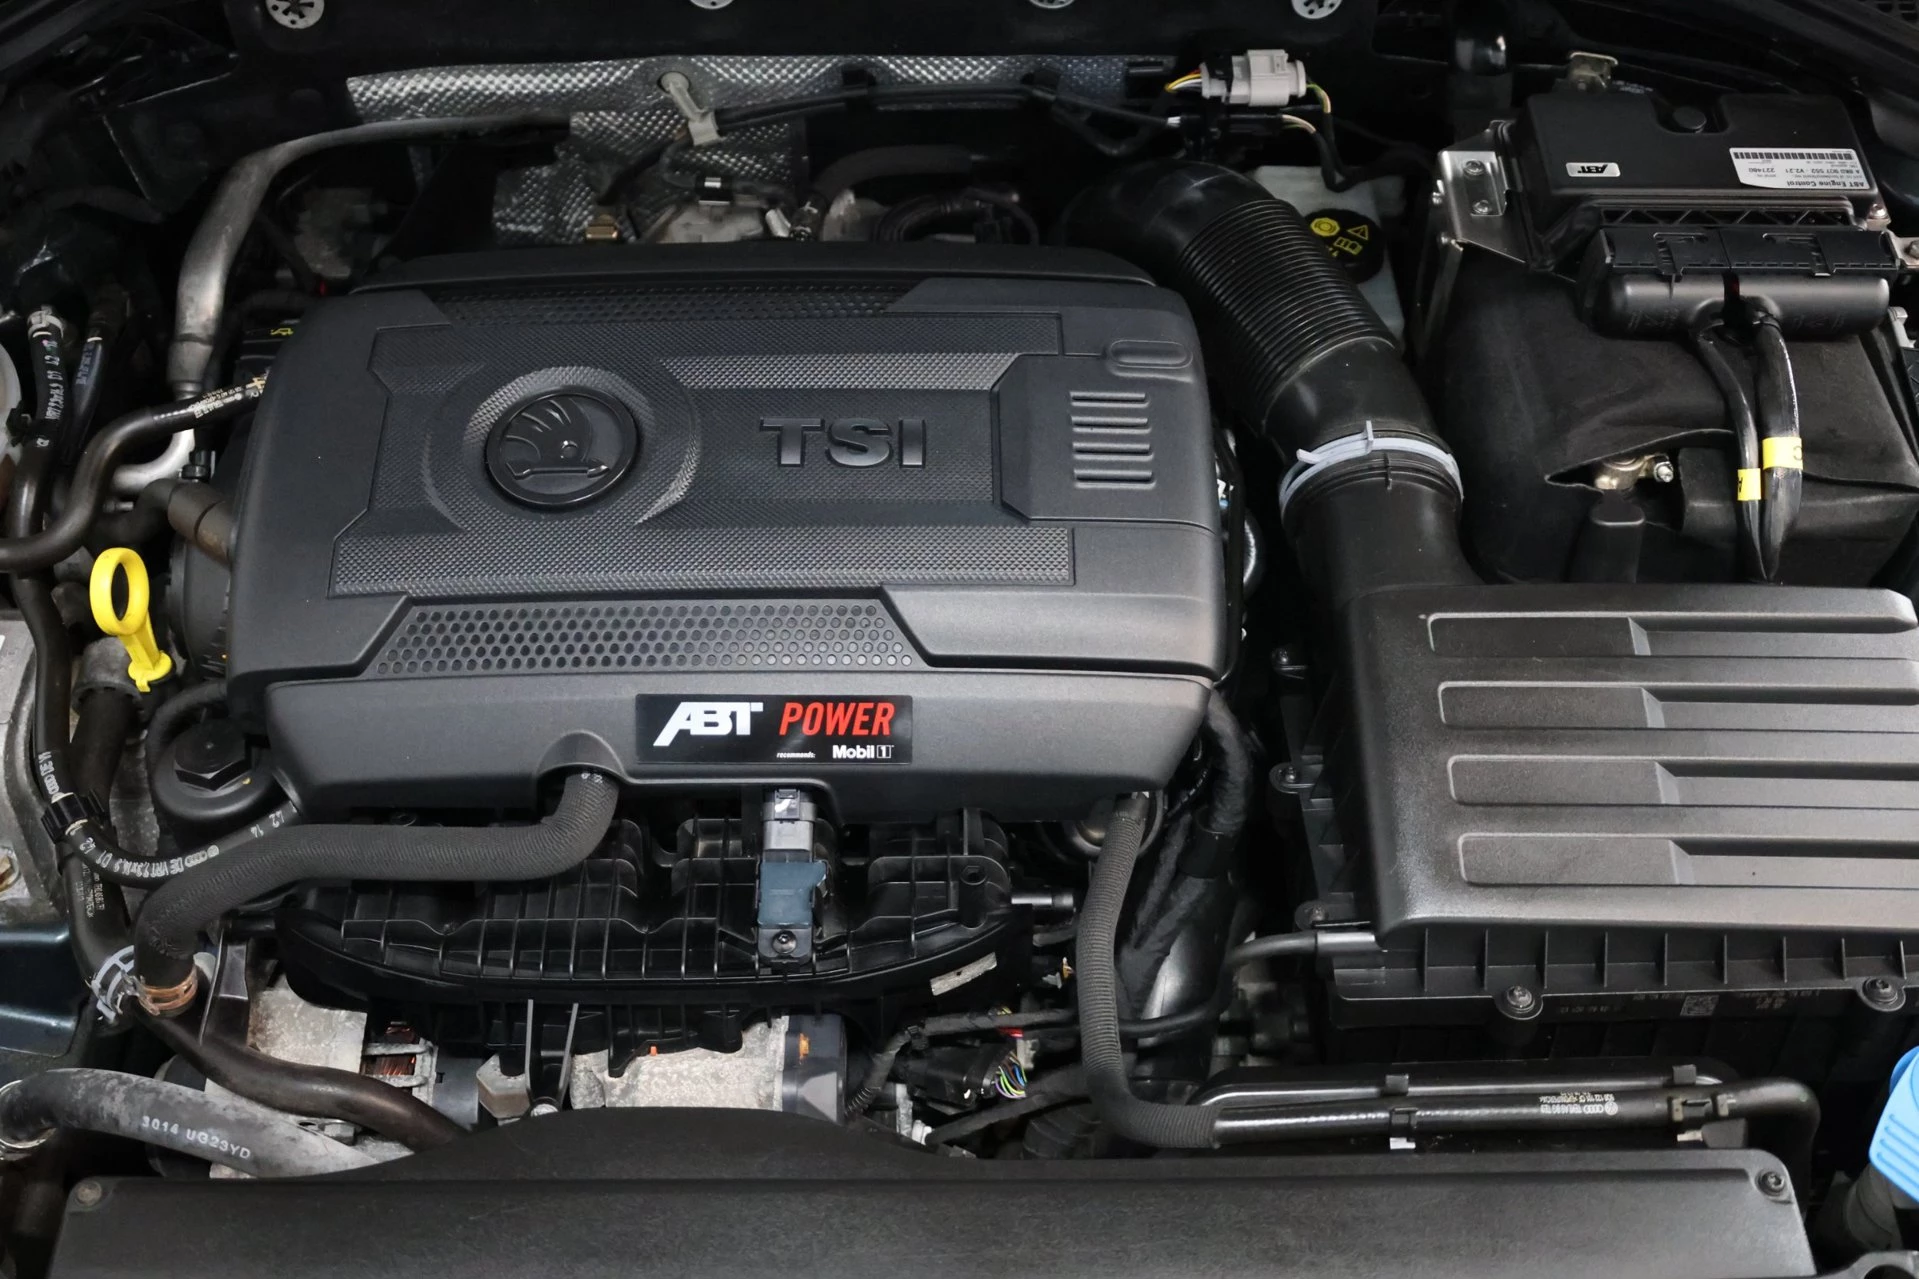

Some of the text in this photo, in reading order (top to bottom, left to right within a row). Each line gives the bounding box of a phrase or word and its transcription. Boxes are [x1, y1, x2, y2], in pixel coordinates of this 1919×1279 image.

[1577, 164, 1608, 174] ABT
[759, 417, 926, 468] TSI
[653, 702, 895, 746] ABT POWER
[833, 745, 875, 759] Mobil
[170, 857, 184, 875] DE
[141, 1115, 251, 1159] 3014 UG23YD
